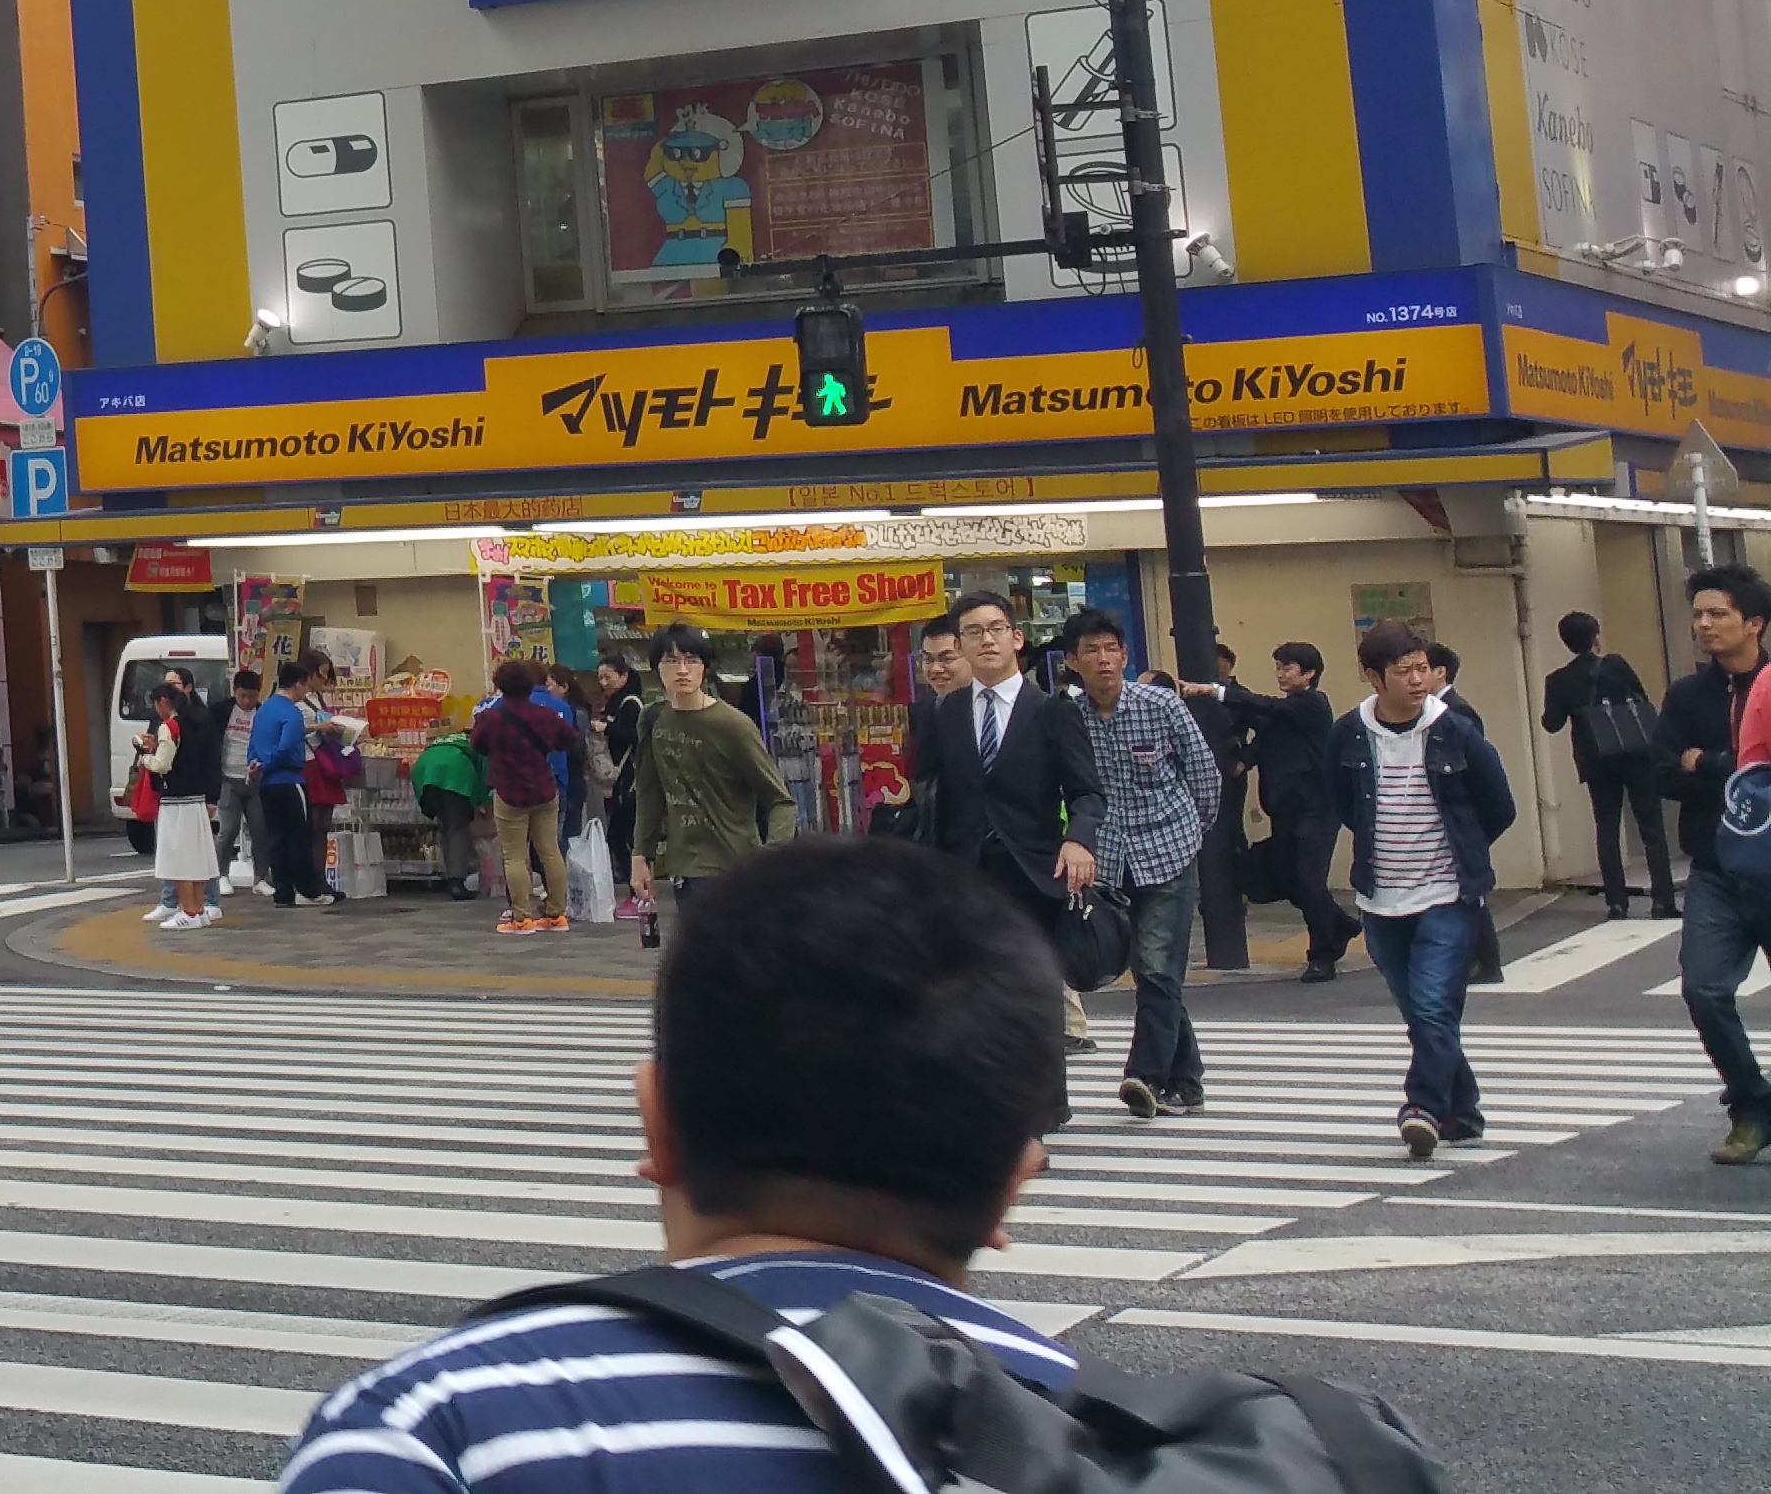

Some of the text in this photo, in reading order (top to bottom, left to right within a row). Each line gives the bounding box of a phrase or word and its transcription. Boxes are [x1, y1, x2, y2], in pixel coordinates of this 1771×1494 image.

[829, 112, 906, 141] SOFINA
[832, 97, 911, 127] Kanebo
[1536, 90, 1594, 156] Kanebo
[1365, 304, 1458, 325] NO.1374号店
[19, 357, 50, 405] P 60
[1230, 356, 1407, 402] KiYoshi
[1516, 352, 1614, 403] Matsumoto KiYoshi
[99, 395, 147, 409] アキバ店
[1262, 410, 1296, 426] LED
[135, 415, 486, 466] Matsumoto KiYoshi
[27, 457, 58, 517] P
[849, 477, 1016, 504] No.1 드럭스토어
[443, 495, 582, 525] 日本最大的药店
[647, 575, 717, 591] Welcome to
[651, 570, 937, 610] Japan! Tax Free Shop
